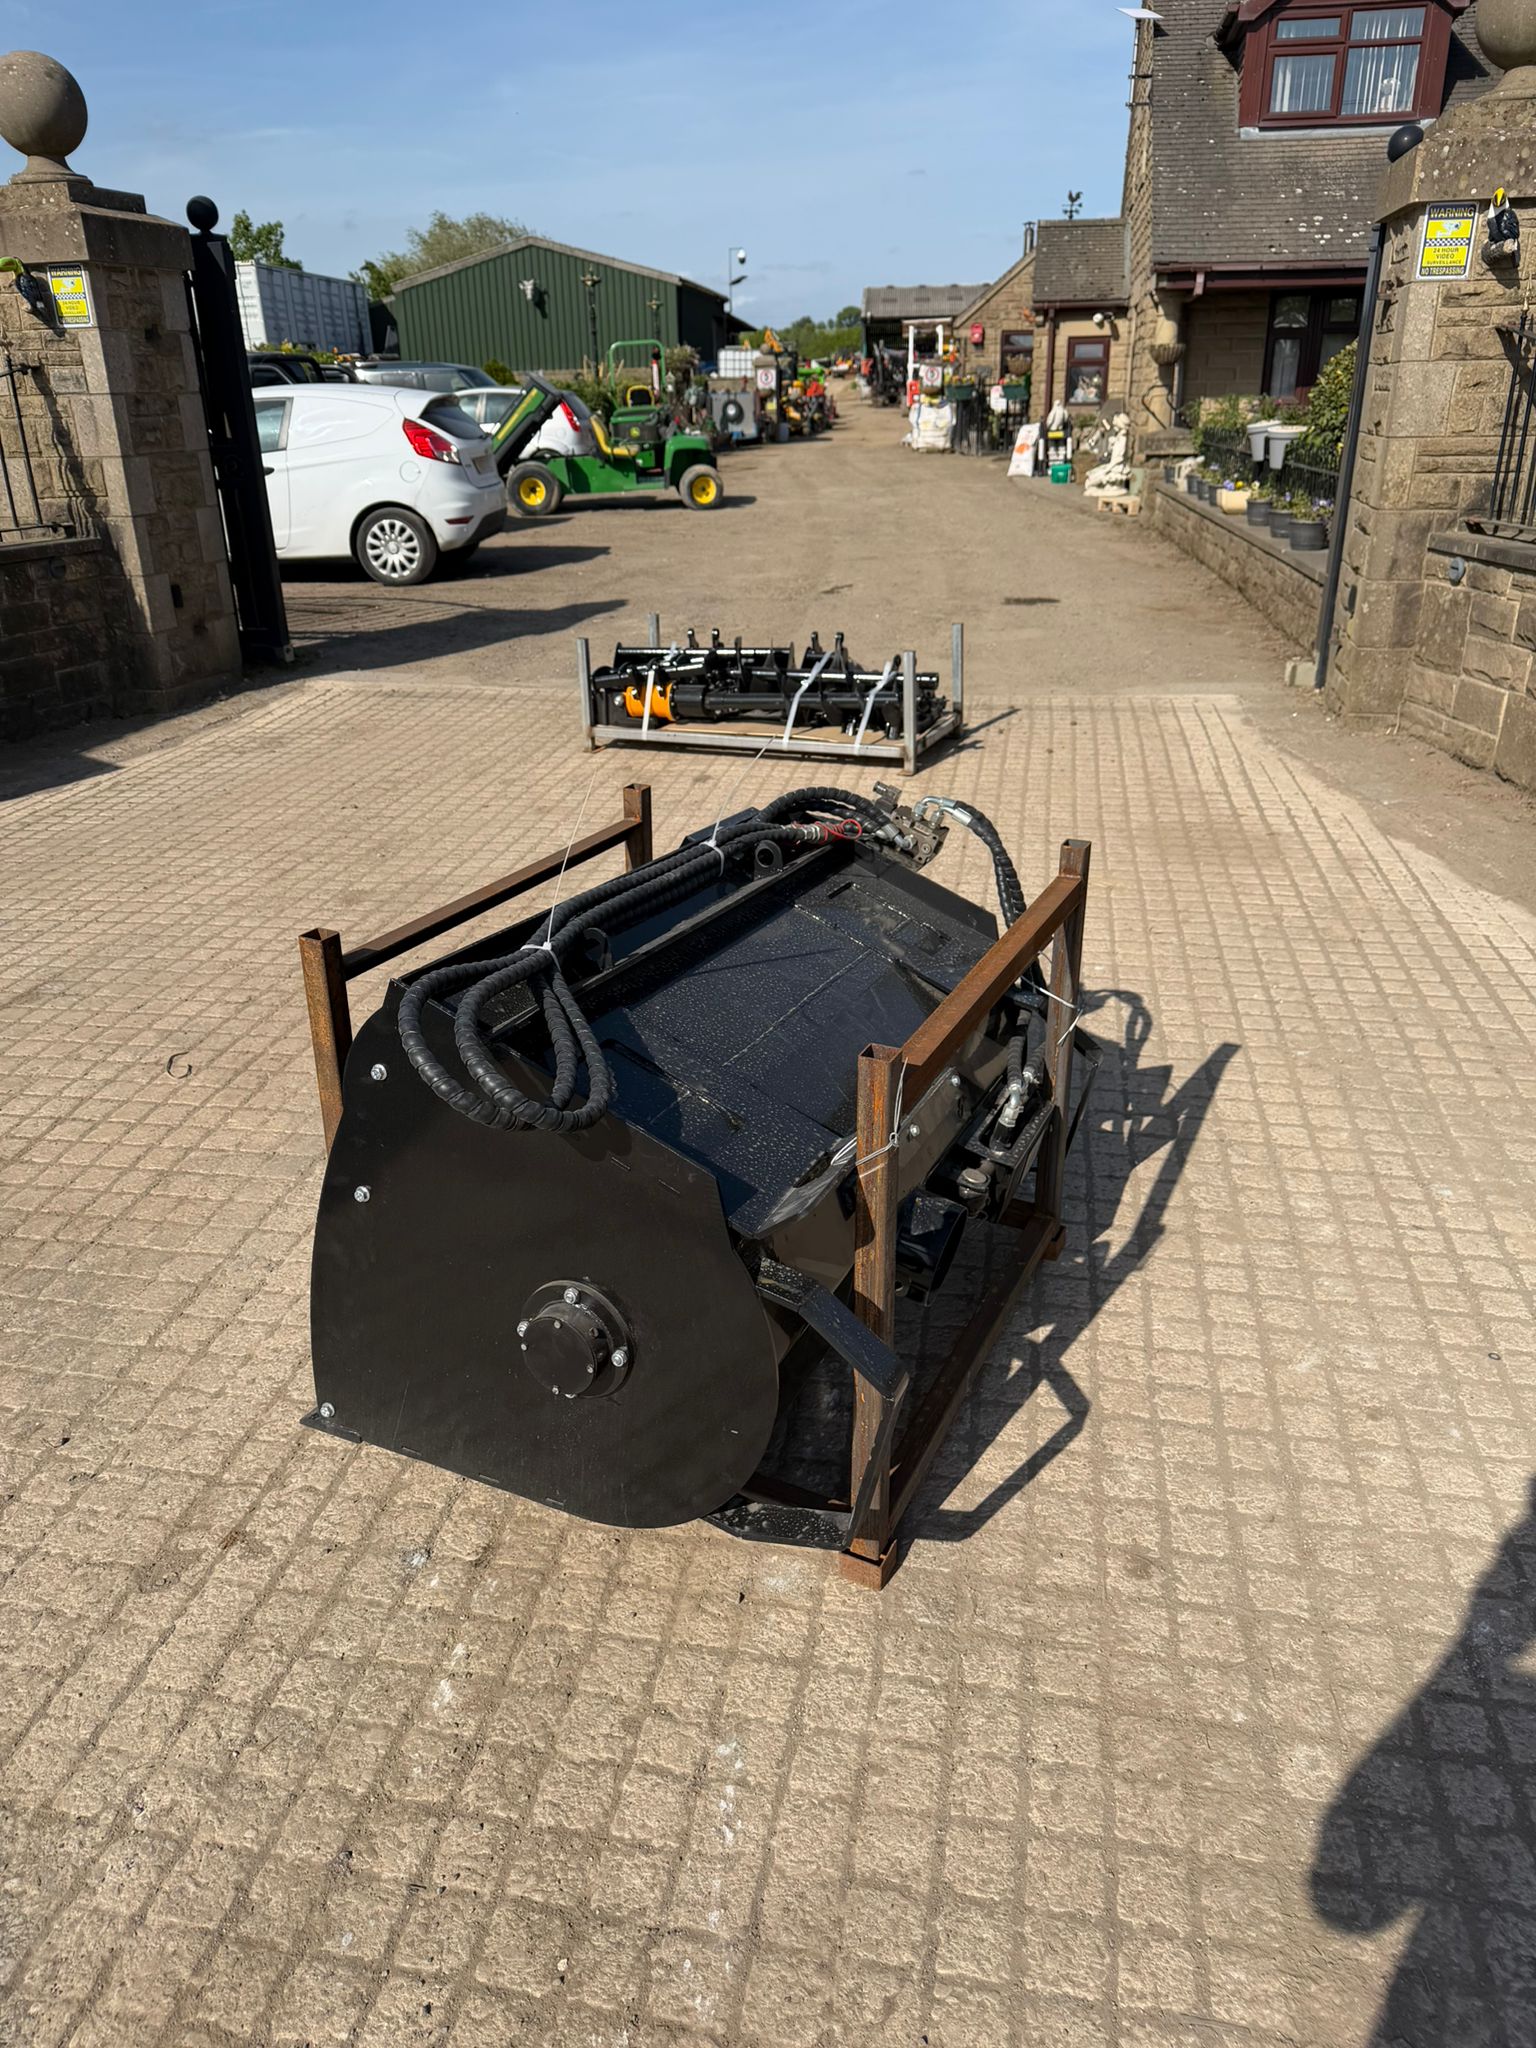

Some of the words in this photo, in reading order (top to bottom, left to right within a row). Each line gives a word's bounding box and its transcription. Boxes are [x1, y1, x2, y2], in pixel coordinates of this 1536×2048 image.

[1430, 207, 1474, 218] WARNING
[1421, 267, 1429, 275] NO
[1430, 267, 1464, 275] TRESPASSING
